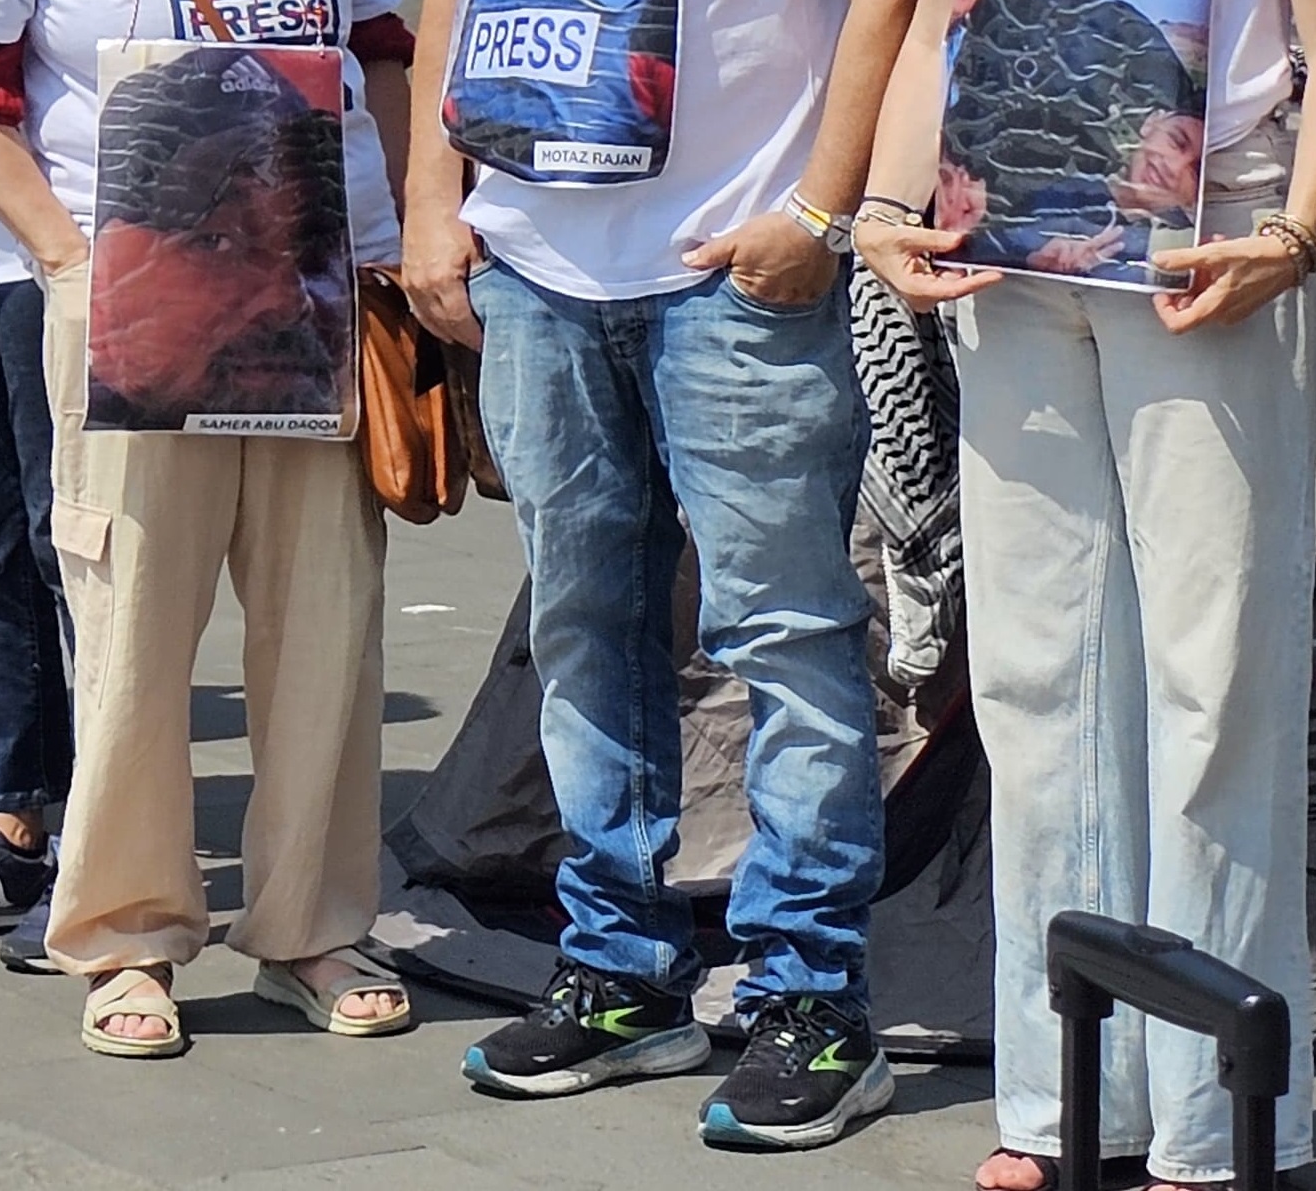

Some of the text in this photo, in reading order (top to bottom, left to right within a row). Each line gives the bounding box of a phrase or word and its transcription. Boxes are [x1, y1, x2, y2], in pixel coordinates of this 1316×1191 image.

[471, 16, 586, 71] PRESS
[541, 150, 642, 166] MOTAZ RAJAN
[199, 419, 250, 430] SAMER
[253, 419, 284, 430] ABU
